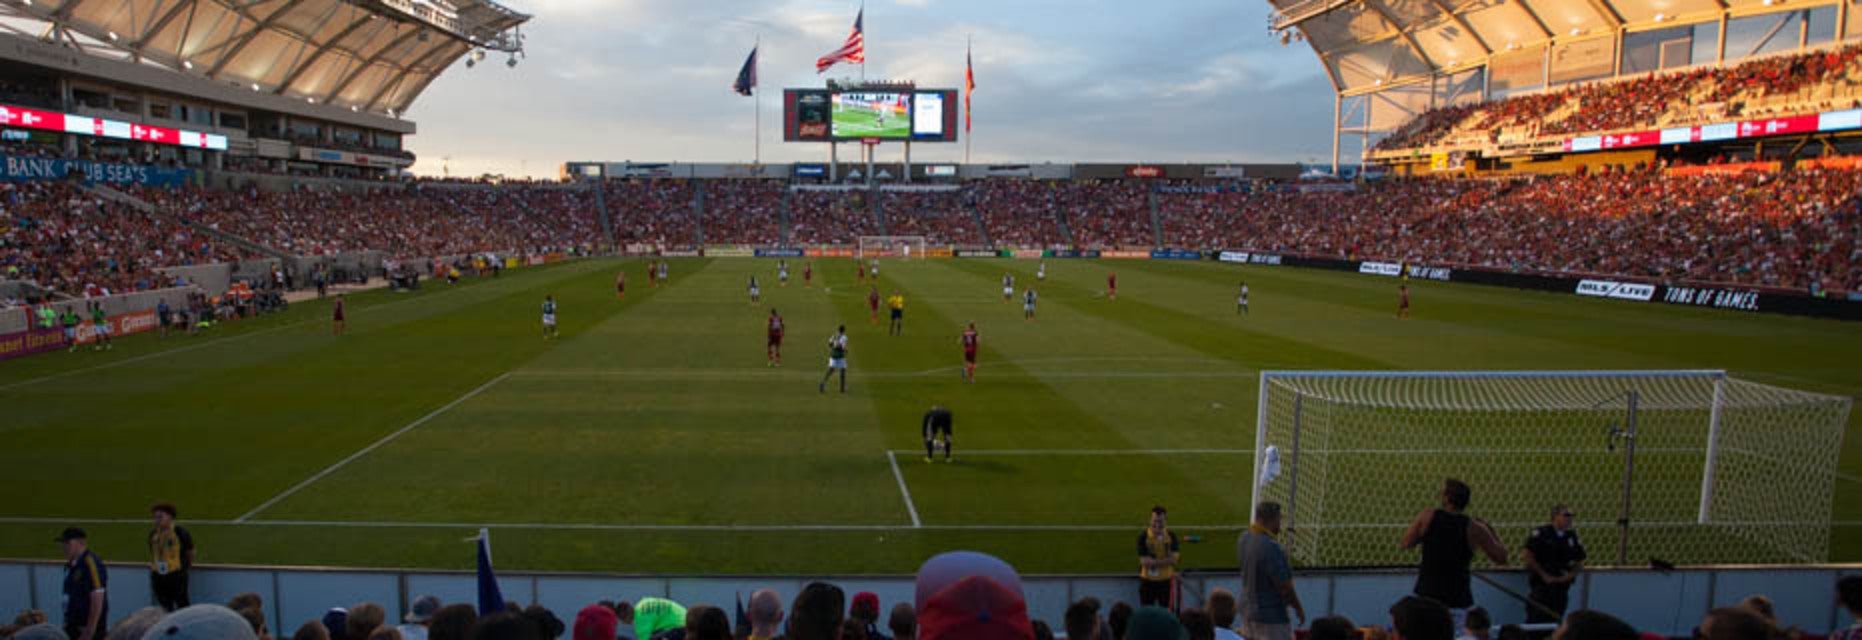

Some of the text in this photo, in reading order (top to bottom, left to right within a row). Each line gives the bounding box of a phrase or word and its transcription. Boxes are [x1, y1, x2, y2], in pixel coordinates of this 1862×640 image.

[7, 157, 55, 177] BANK
[1663, 286, 1695, 304] TONS
[1695, 289, 1713, 305] OF
